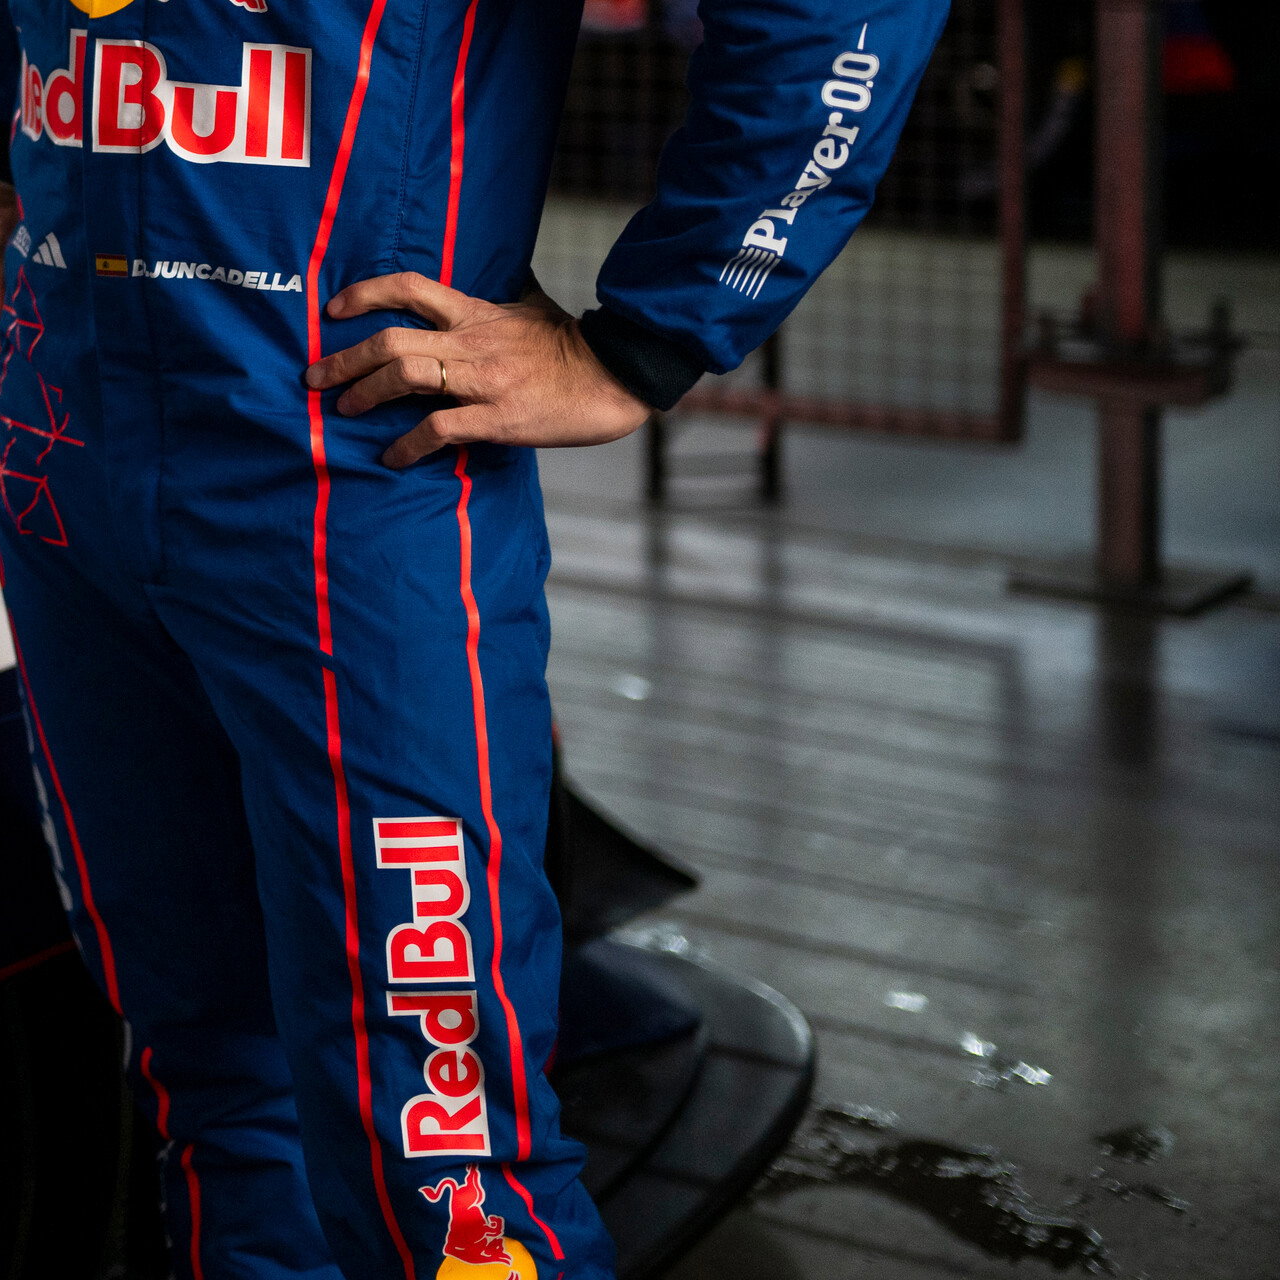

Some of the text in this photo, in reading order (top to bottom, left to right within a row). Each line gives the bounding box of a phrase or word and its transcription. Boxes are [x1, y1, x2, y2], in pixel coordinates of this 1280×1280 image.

[92, 38, 313, 168] Bull
[131, 259, 304, 293] D.JUNCADELLA
[371, 816, 492, 1159] Red Bull
